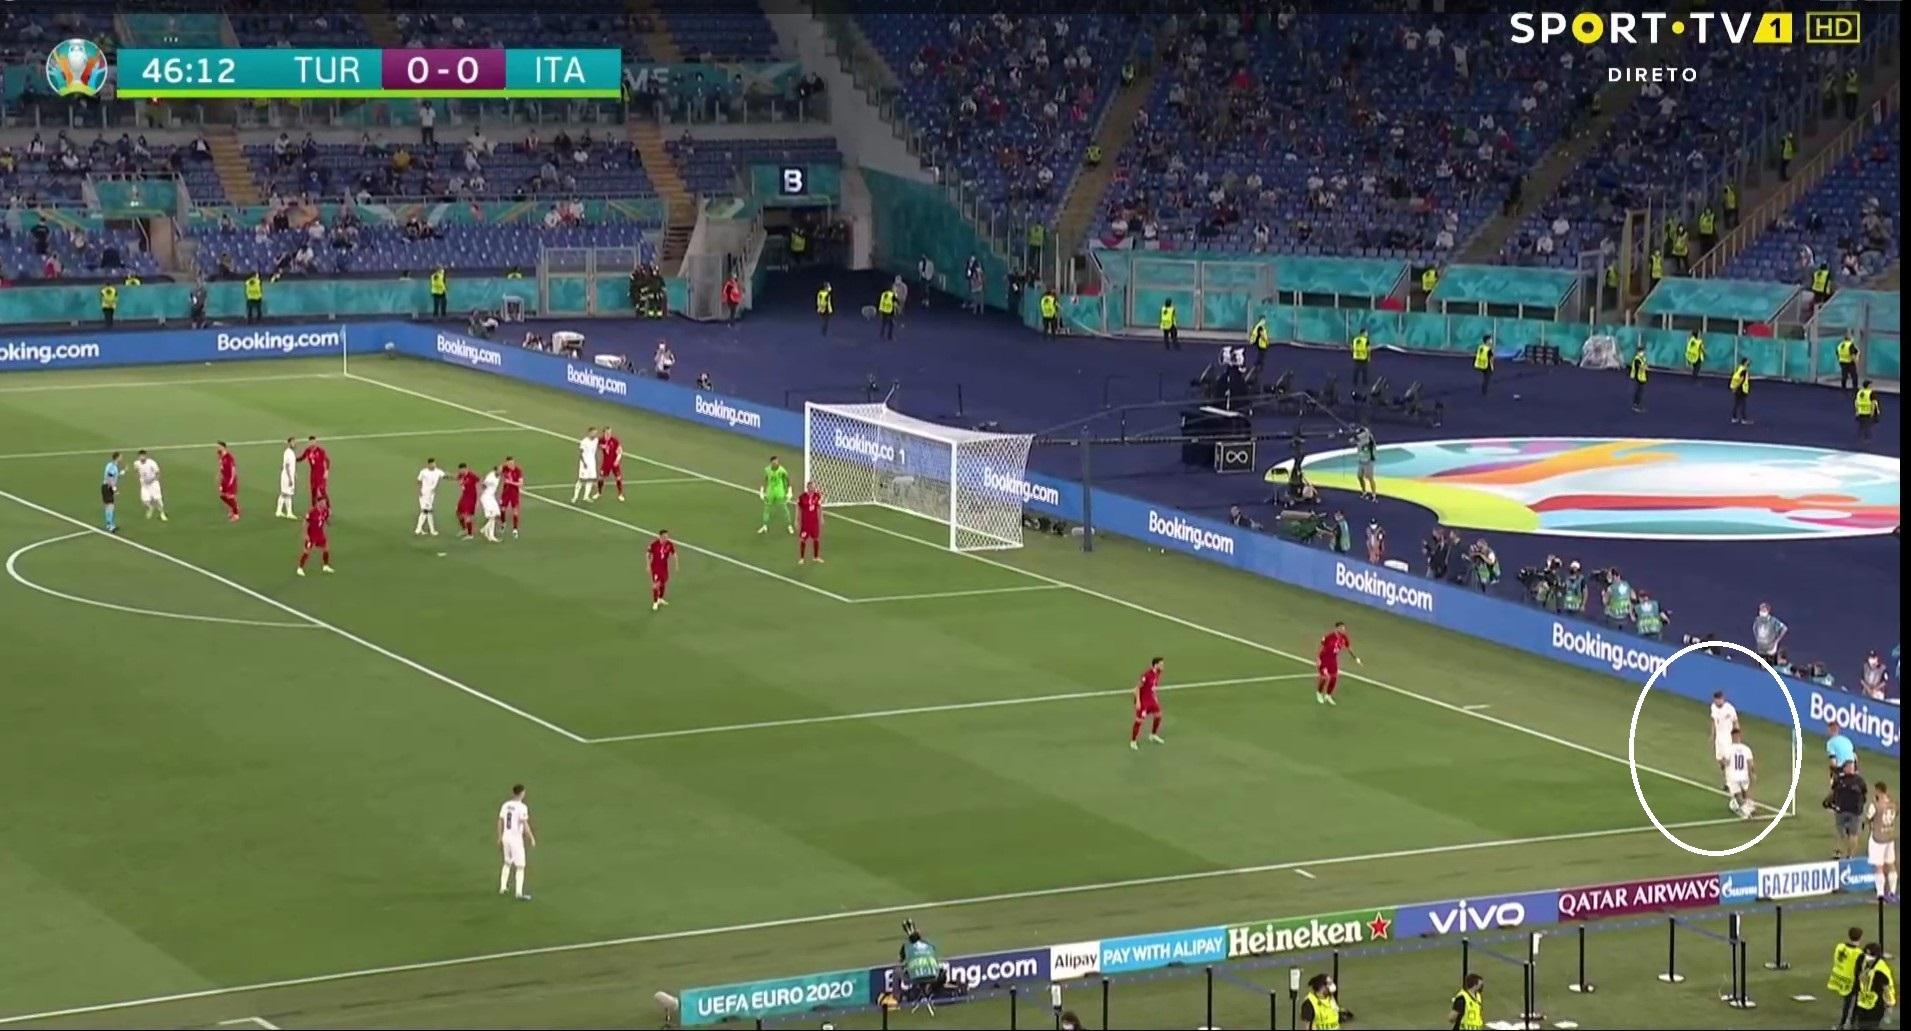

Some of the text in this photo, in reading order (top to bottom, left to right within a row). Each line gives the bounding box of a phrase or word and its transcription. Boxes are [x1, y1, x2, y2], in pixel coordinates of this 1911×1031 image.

[784, 170, 803, 192] B
[217, 331, 339, 352] Booking.com
[437, 334, 501, 366] Booking.com
[567, 363, 627, 396] Booking.com
[695, 394, 761, 429] Booking.com
[1149, 510, 1234, 556] Booking.com
[1336, 561, 1433, 611] Booking.com
[1552, 622, 1667, 678] Booking.com
[1734, 754, 1745, 771] 10
[1558, 878, 1720, 916] QATAR AIRWAYS
[1762, 868, 1837, 897] GAZPROM
[1428, 899, 1525, 934] vivo
[1103, 936, 1224, 966] PAY WITH ALIPAY
[1229, 919, 1363, 957] Heineken
[1054, 953, 1098, 969] Alipay
[698, 980, 854, 1016] UEFA EURO 2020
